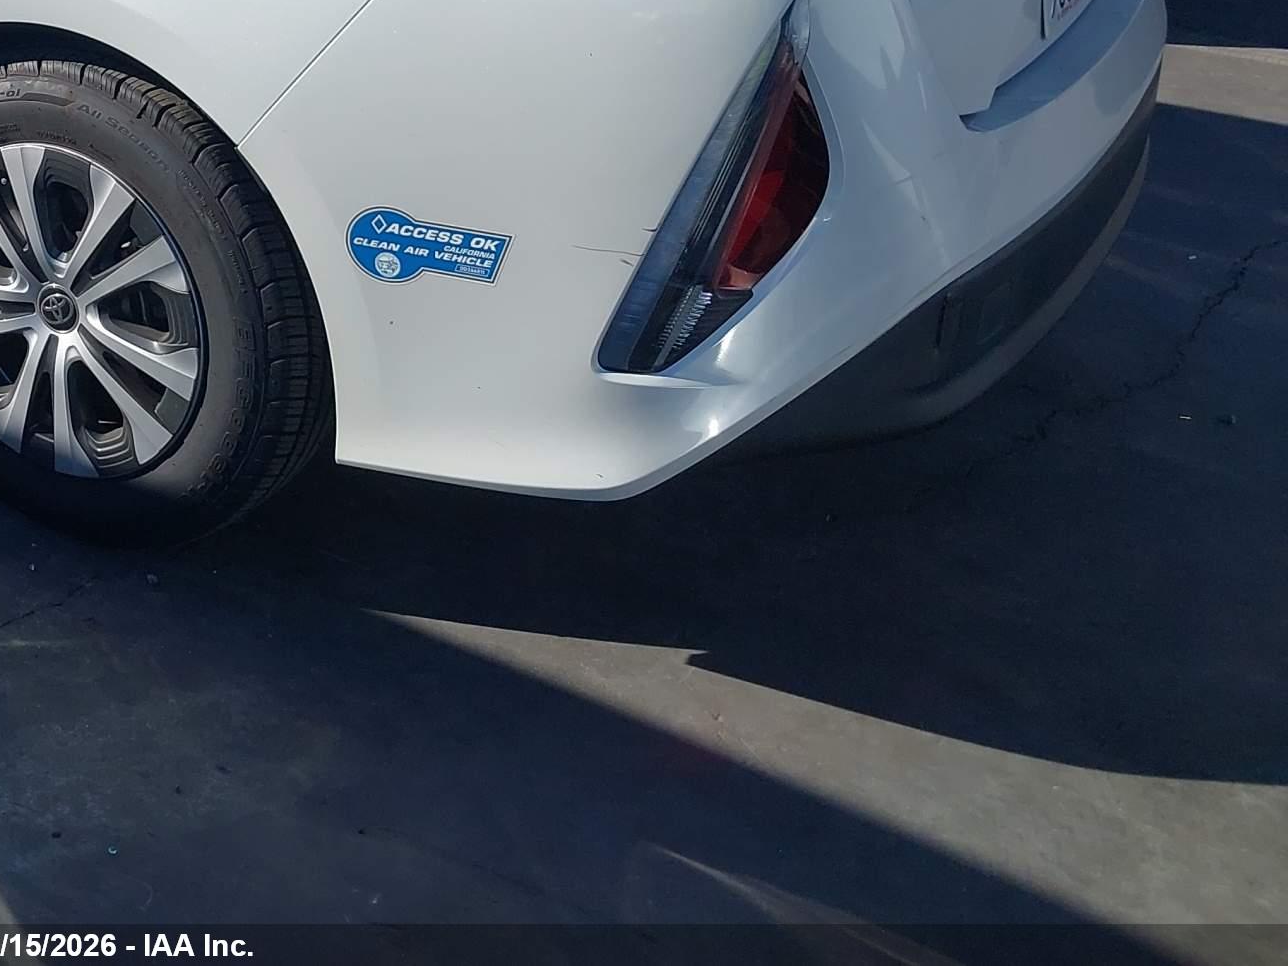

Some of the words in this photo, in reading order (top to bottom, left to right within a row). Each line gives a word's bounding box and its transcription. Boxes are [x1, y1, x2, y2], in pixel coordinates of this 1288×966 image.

[385, 223, 465, 246] ACCESS
[470, 237, 501, 252] OK
[353, 237, 400, 252] CLEAN
[404, 246, 430, 257] AIR
[434, 250, 494, 268] VEHICLE
[443, 245, 495, 260] CALIFORNIA
